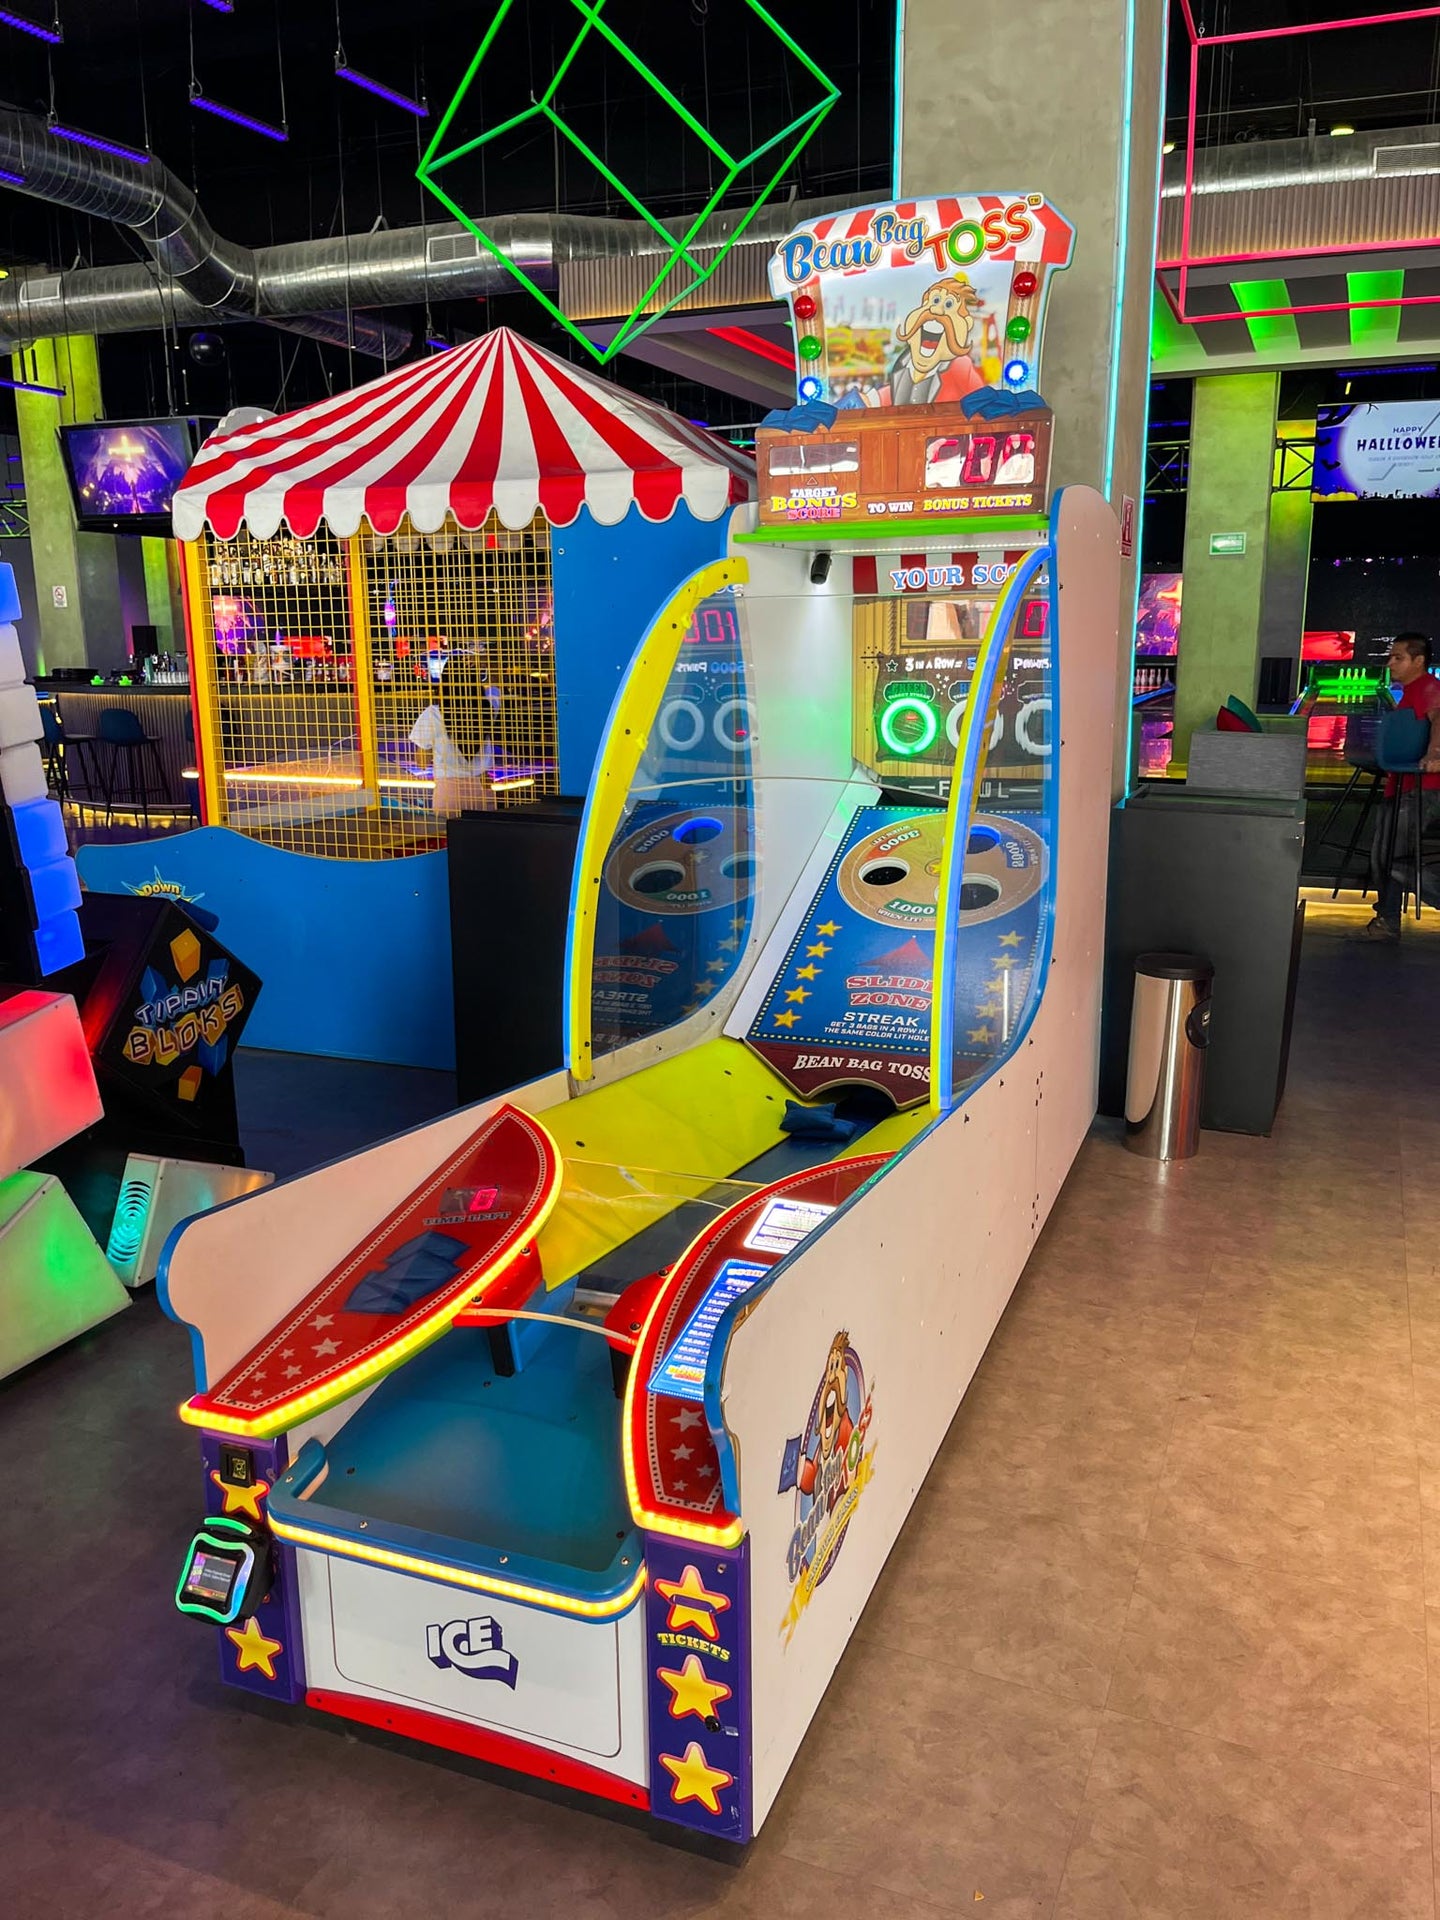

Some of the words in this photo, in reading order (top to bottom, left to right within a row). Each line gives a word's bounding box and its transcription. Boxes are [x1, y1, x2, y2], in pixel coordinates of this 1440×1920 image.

[781, 234, 880, 281] Bean
[873, 214, 926, 256] Bag
[924, 203, 1032, 272] TOSS
[771, 492, 858, 512] BONUS
[790, 487, 838, 498] TARGET
[787, 507, 841, 520] SCORE
[868, 502, 886, 514] TO
[888, 501, 914, 513] WIN
[923, 498, 969, 511] BONUS
[972, 494, 1033, 509] TICKETS
[891, 567, 964, 590] YOUR
[905, 657, 914, 672] 3
[916, 660, 924, 669] IN
[926, 660, 933, 669] A
[939, 780, 1009, 798] FUL
[142, 881, 181, 897] Down
[850, 992, 932, 1011] ZONE
[129, 989, 242, 1061] BLOKS
[843, 1011, 920, 1026] STREAK
[856, 1023, 879, 1031] BAGS
[841, 1027, 864, 1036] SAME
[866, 1030, 893, 1038] COLOR
[793, 1055, 844, 1070] BEAN
[847, 1058, 883, 1071] BAG
[888, 1062, 931, 1083] TOSS
[426, 1615, 519, 1691] ICE
[657, 1632, 731, 1661] TICKETS
